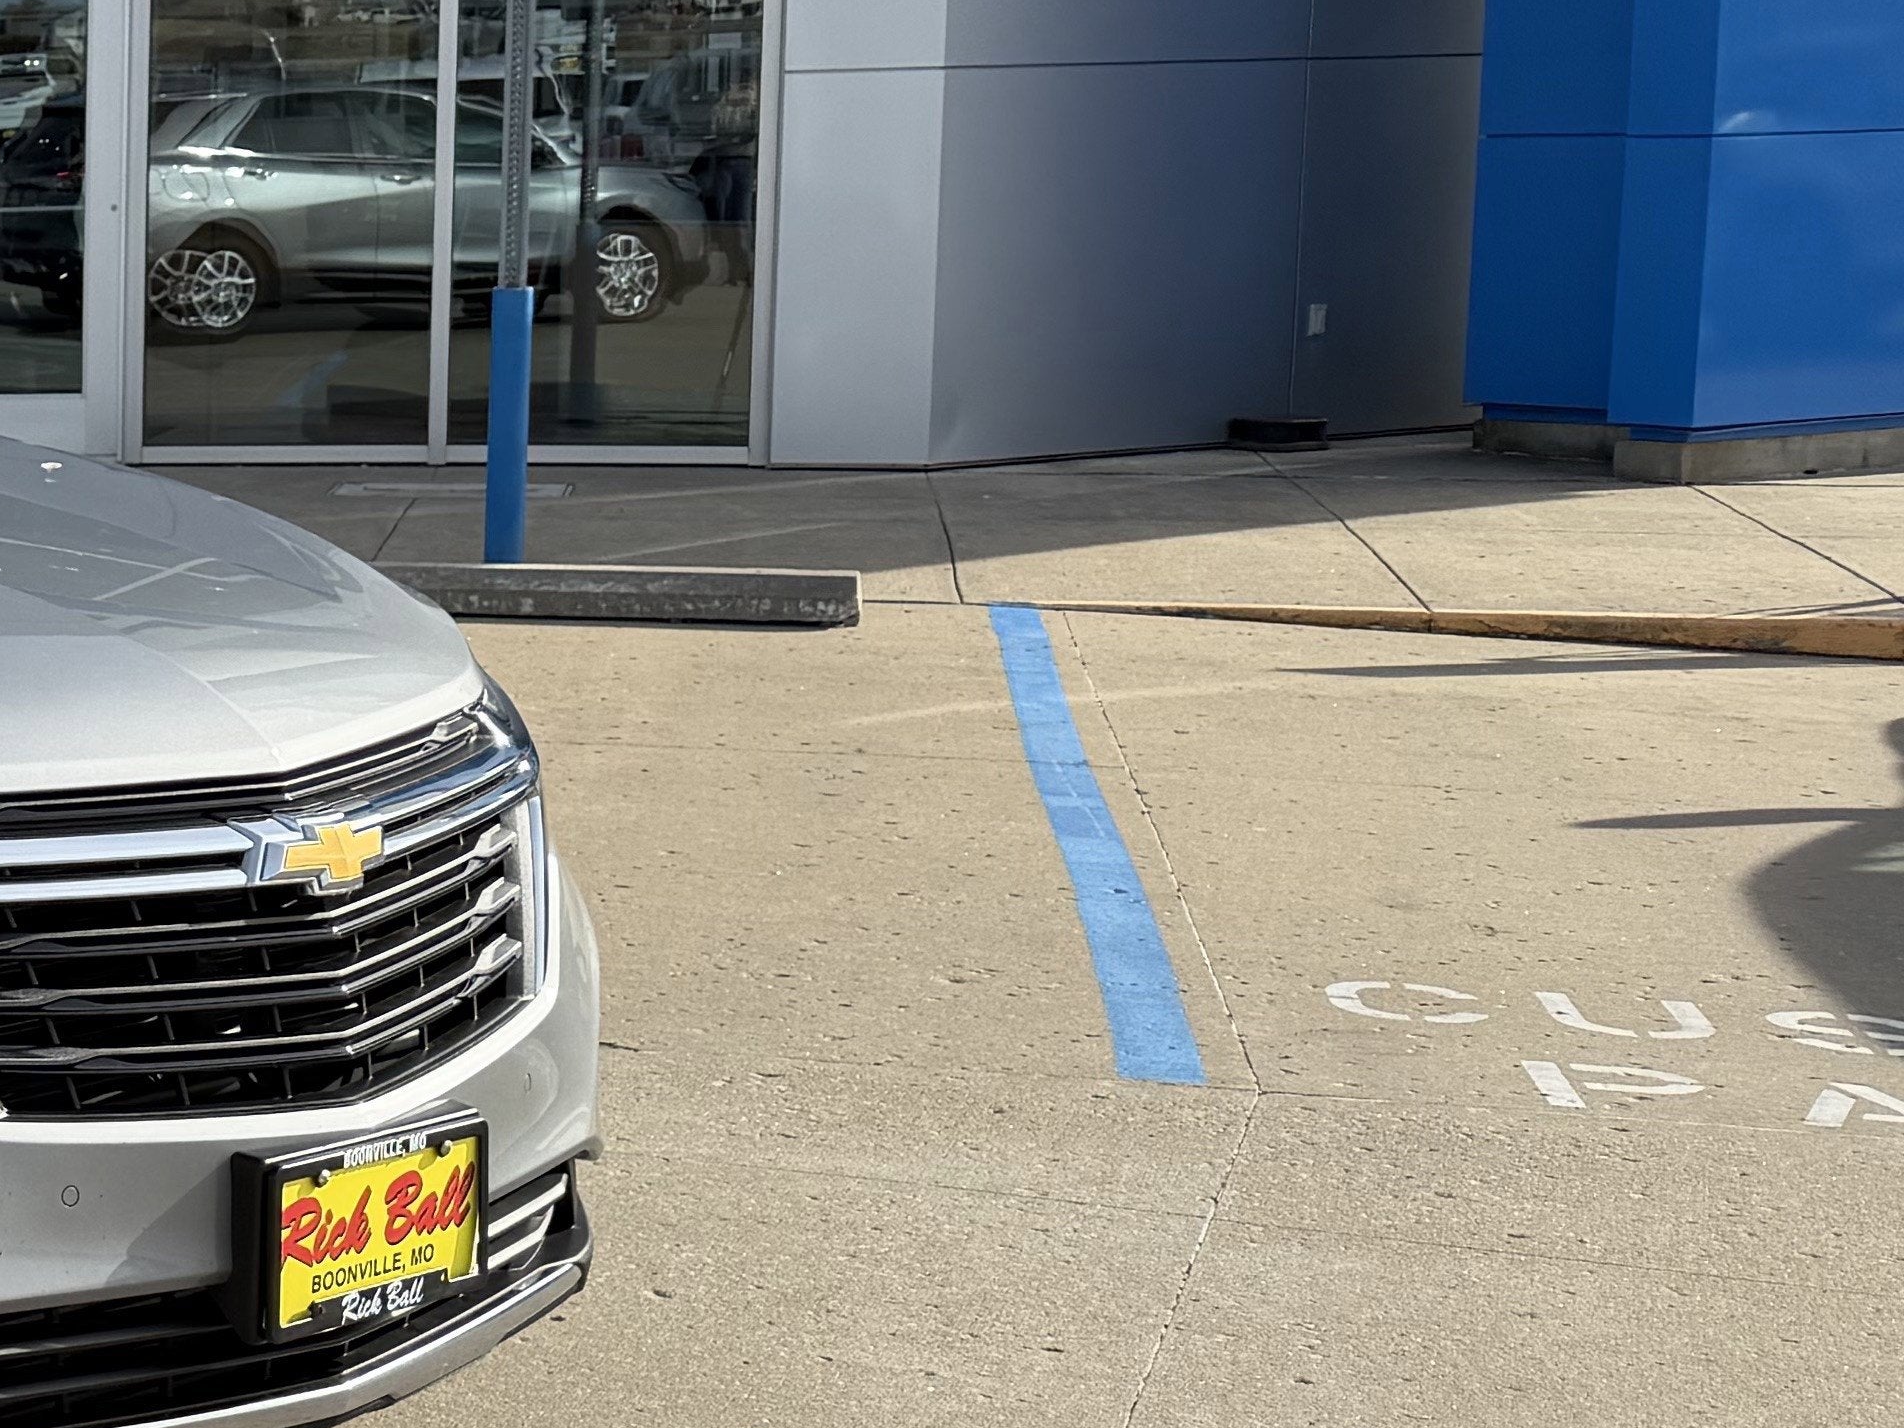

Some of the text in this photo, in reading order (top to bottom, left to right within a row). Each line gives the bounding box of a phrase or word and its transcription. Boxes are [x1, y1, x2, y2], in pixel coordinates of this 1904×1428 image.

[342, 1132, 428, 1169] BOONVILLE, MO
[281, 1160, 476, 1268] Rick Ball
[311, 1243, 435, 1294] BOONVILLE, MO
[342, 1277, 424, 1325] Rick Ball
